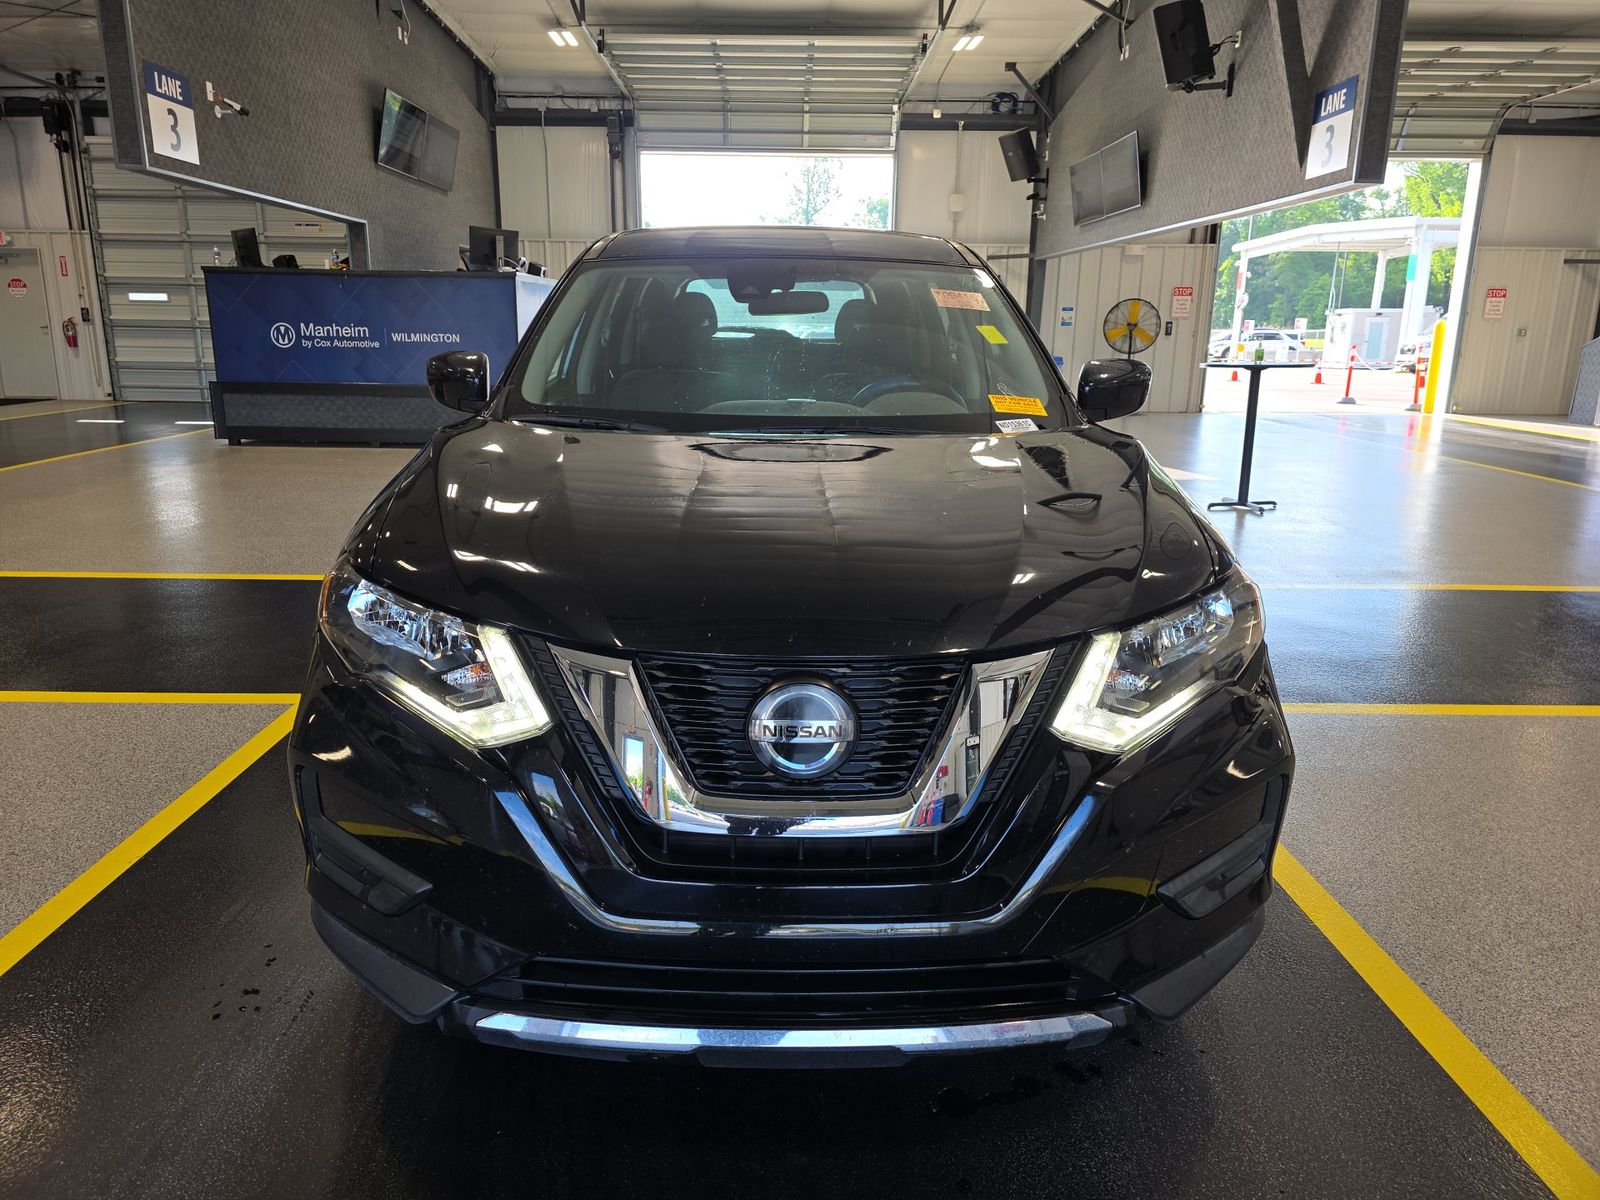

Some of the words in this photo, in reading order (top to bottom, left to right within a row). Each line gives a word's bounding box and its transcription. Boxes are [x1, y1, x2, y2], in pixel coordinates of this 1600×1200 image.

[154, 71, 183, 101] LANE
[1320, 87, 1347, 117] LANE
[166, 107, 182, 152] 3
[1320, 124, 1335, 168] 3
[1174, 287, 1193, 296] STOP
[1487, 289, 1507, 297] STOP
[300, 322, 369, 338] Manheim
[391, 332, 460, 343] WILMINGTON
[302, 339, 312, 348] by
[314, 338, 331, 347] Cox
[333, 339, 380, 348] Automotive
[762, 724, 842, 738] NISSAN
